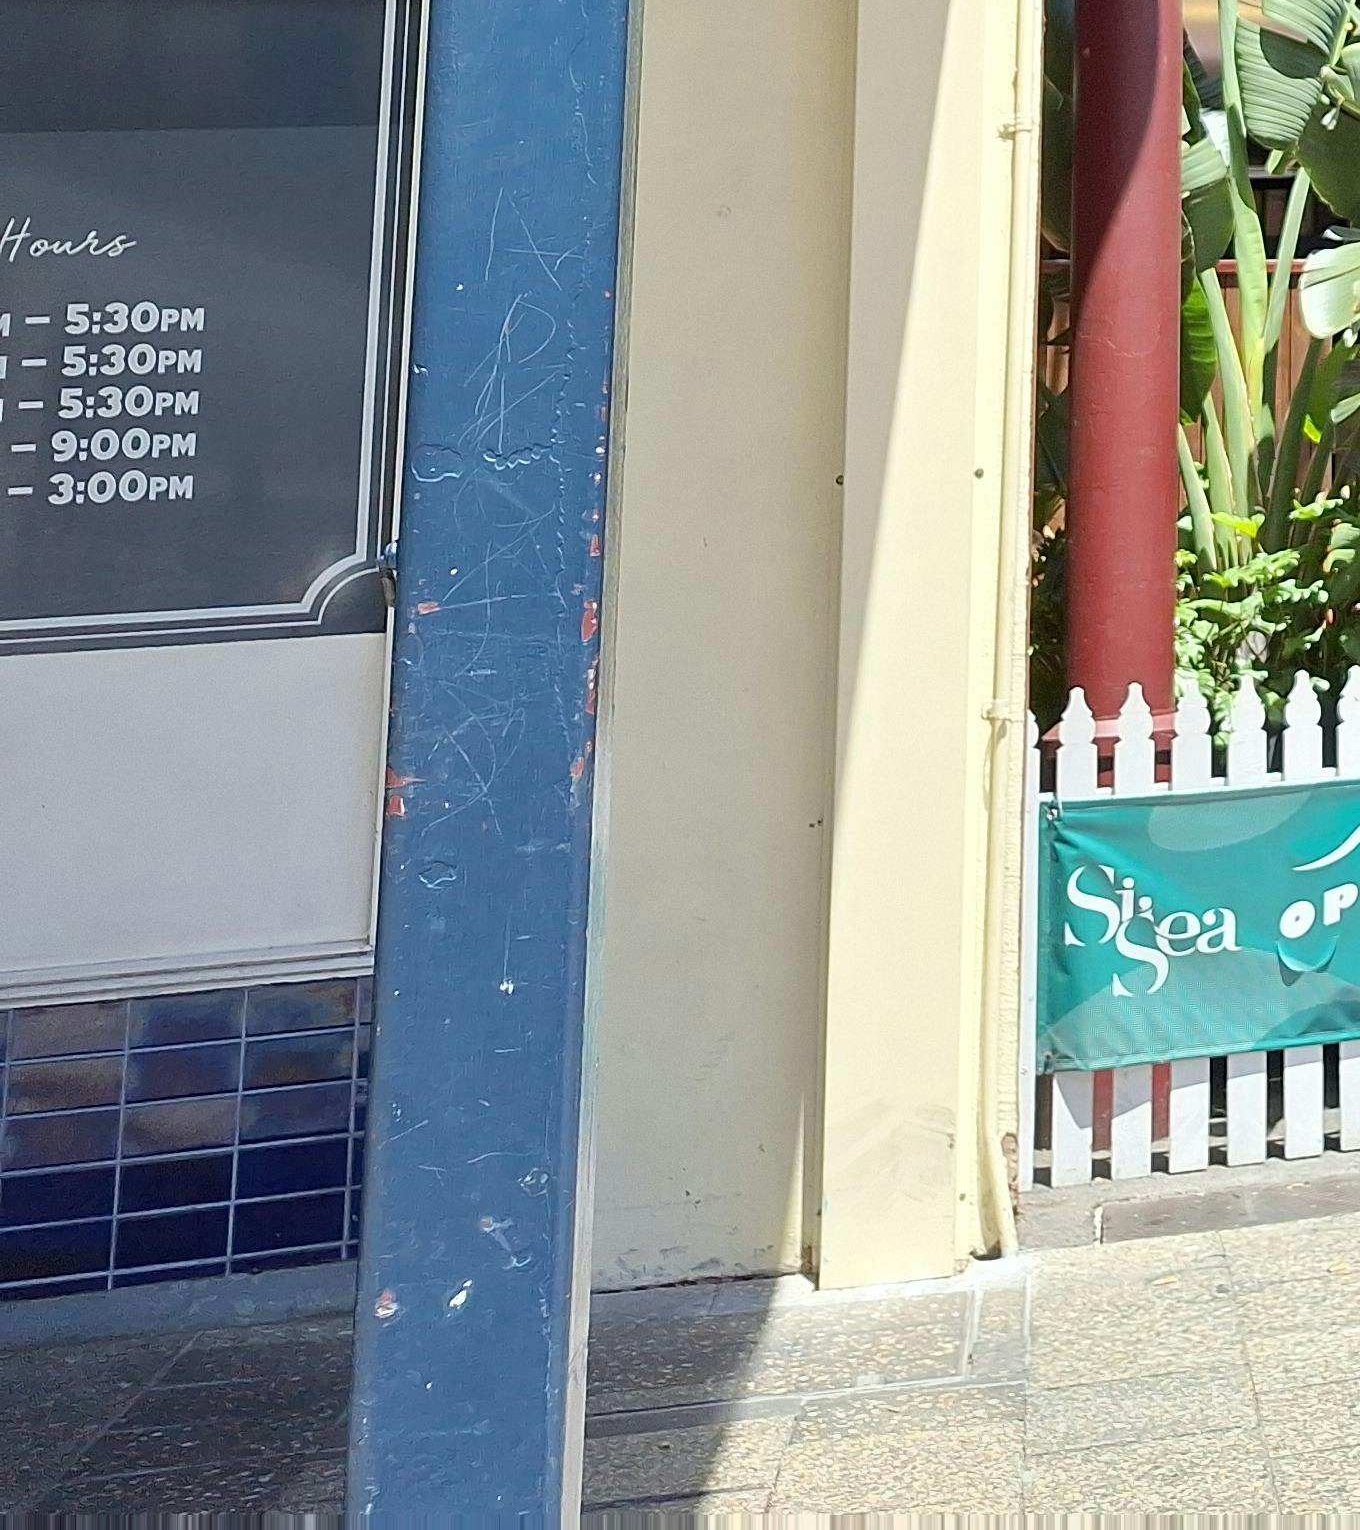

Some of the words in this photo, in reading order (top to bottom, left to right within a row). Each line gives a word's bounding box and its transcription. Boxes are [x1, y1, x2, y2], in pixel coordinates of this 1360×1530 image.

[0, 217, 137, 262] Hours
[64, 301, 205, 335] 5:30PM
[61, 343, 202, 377] 5:30PM
[58, 385, 199, 419] 5:30PM
[51, 427, 196, 462] 9:00PM
[48, 469, 193, 505] 3:00PM
